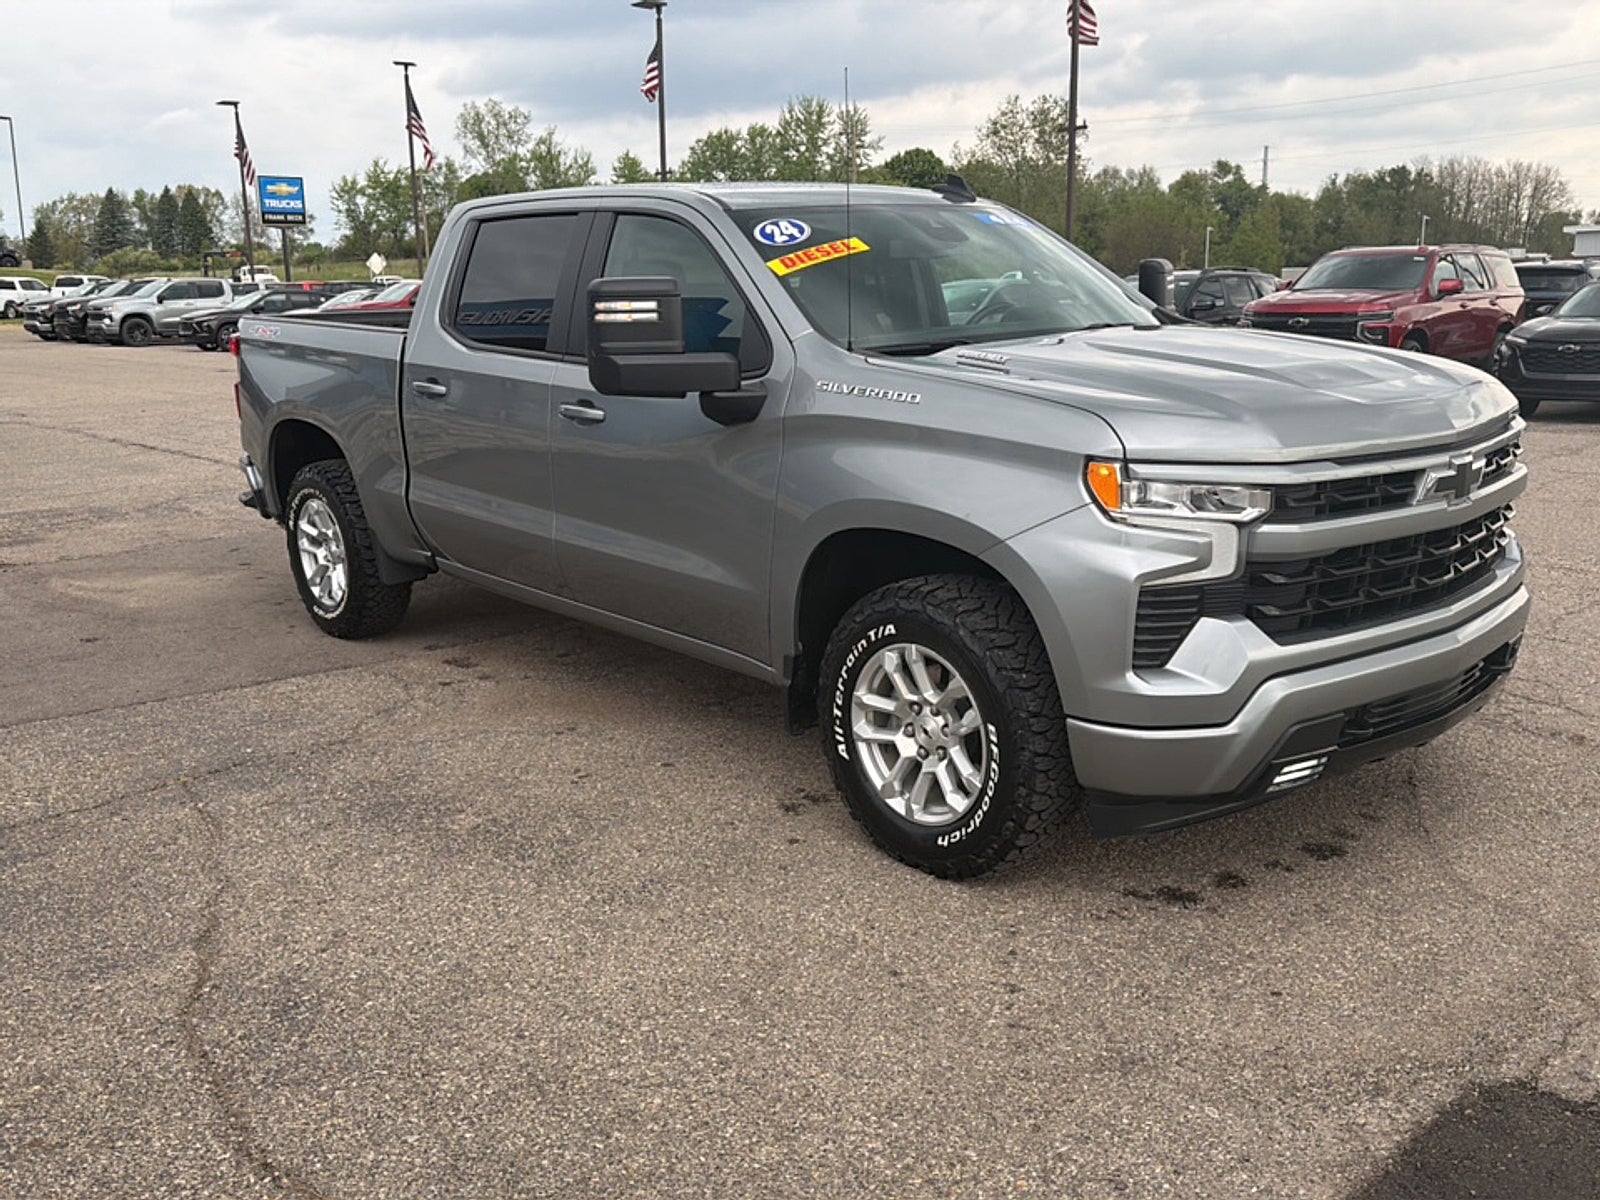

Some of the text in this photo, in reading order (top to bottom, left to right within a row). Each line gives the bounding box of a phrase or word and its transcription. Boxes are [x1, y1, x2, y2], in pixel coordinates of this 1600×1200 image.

[264, 199, 303, 208] TRUCKS
[765, 221, 801, 243] 24
[780, 241, 859, 269] DIESEL
[816, 380, 921, 404] SILVERADO
[834, 623, 897, 760] All-Terrain T/A
[936, 723, 1000, 847] BFGoodrich
